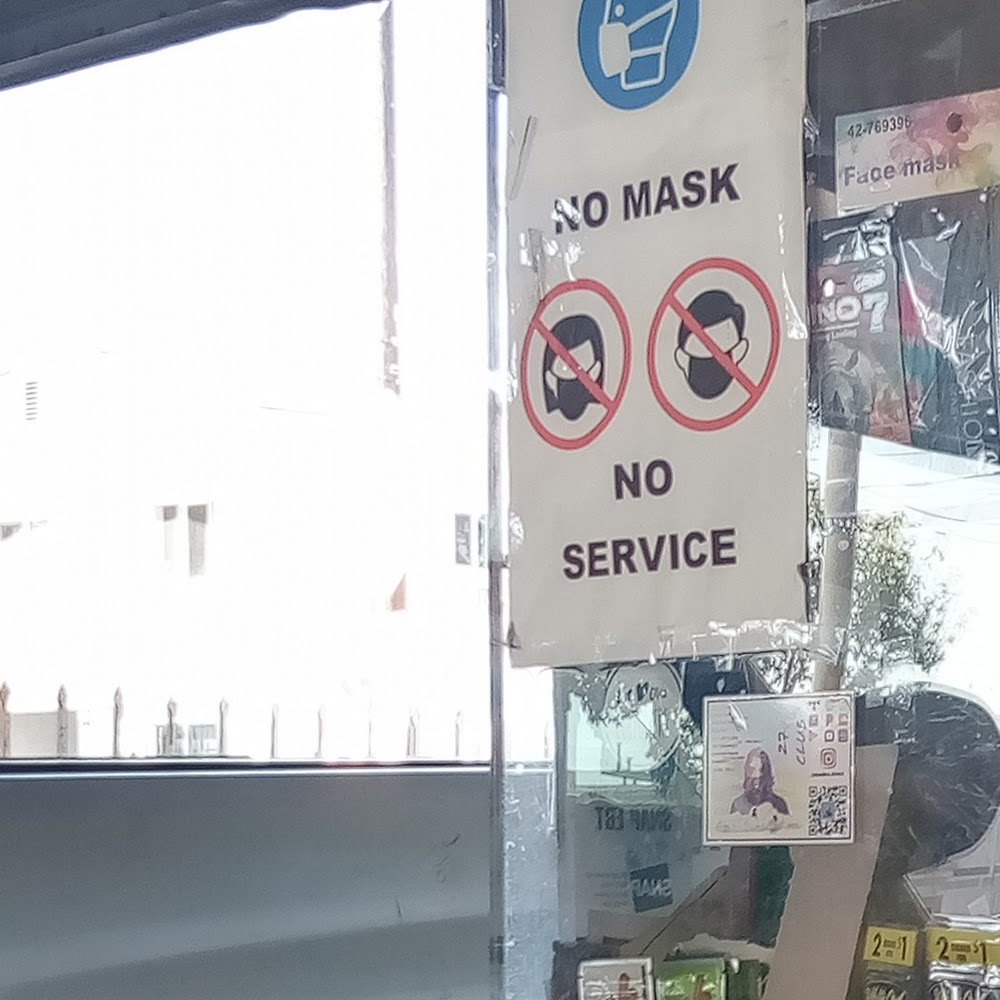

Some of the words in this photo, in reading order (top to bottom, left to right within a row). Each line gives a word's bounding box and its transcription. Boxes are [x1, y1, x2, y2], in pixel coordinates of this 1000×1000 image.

[554, 196, 609, 236] NO
[622, 163, 741, 222] MASK
[614, 458, 673, 500] NO
[563, 528, 737, 580] SERVICE
[872, 932, 882, 957] 2
[935, 936, 950, 961] 2
